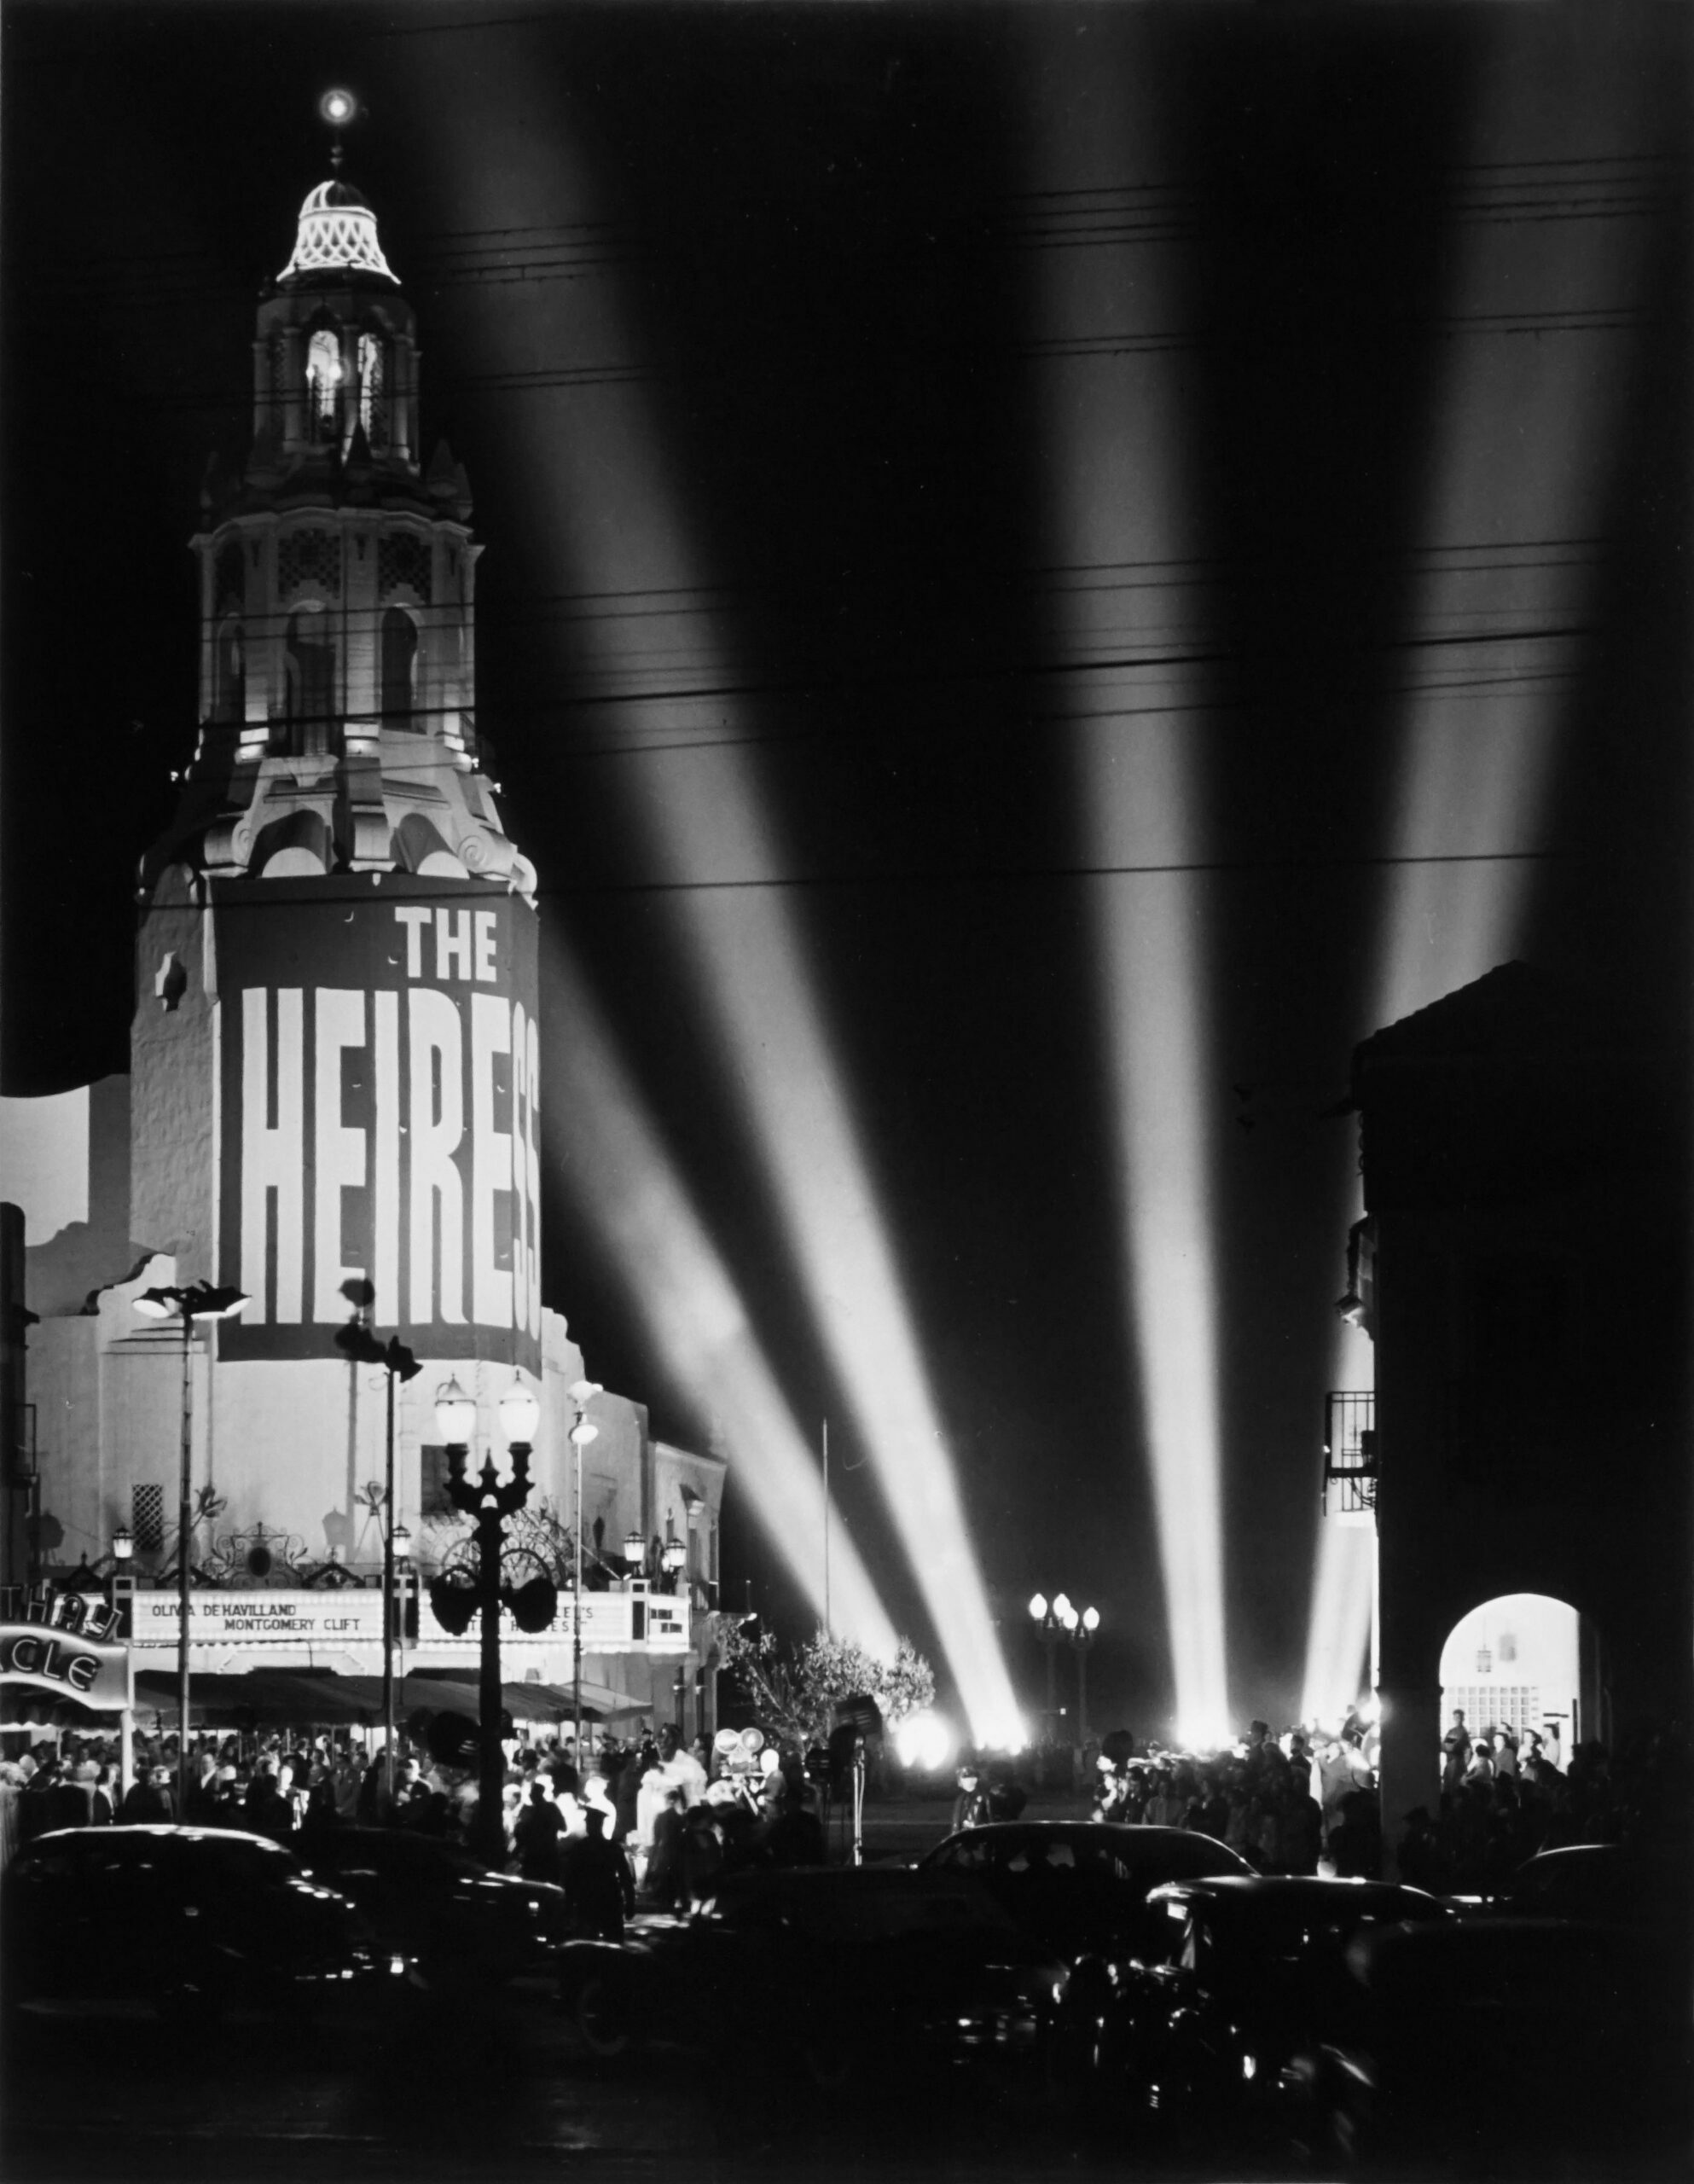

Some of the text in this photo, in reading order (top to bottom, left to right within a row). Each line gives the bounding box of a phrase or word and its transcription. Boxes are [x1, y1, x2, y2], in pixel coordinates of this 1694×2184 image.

[395, 906, 496, 982] THE
[241, 987, 541, 1340] HEIRESS
[152, 1605, 296, 1617] OLIVA DE HAVILLAND
[224, 1618, 360, 1631] MONTGOMERY CLIFT
[0, 1637, 99, 1690] CLE
